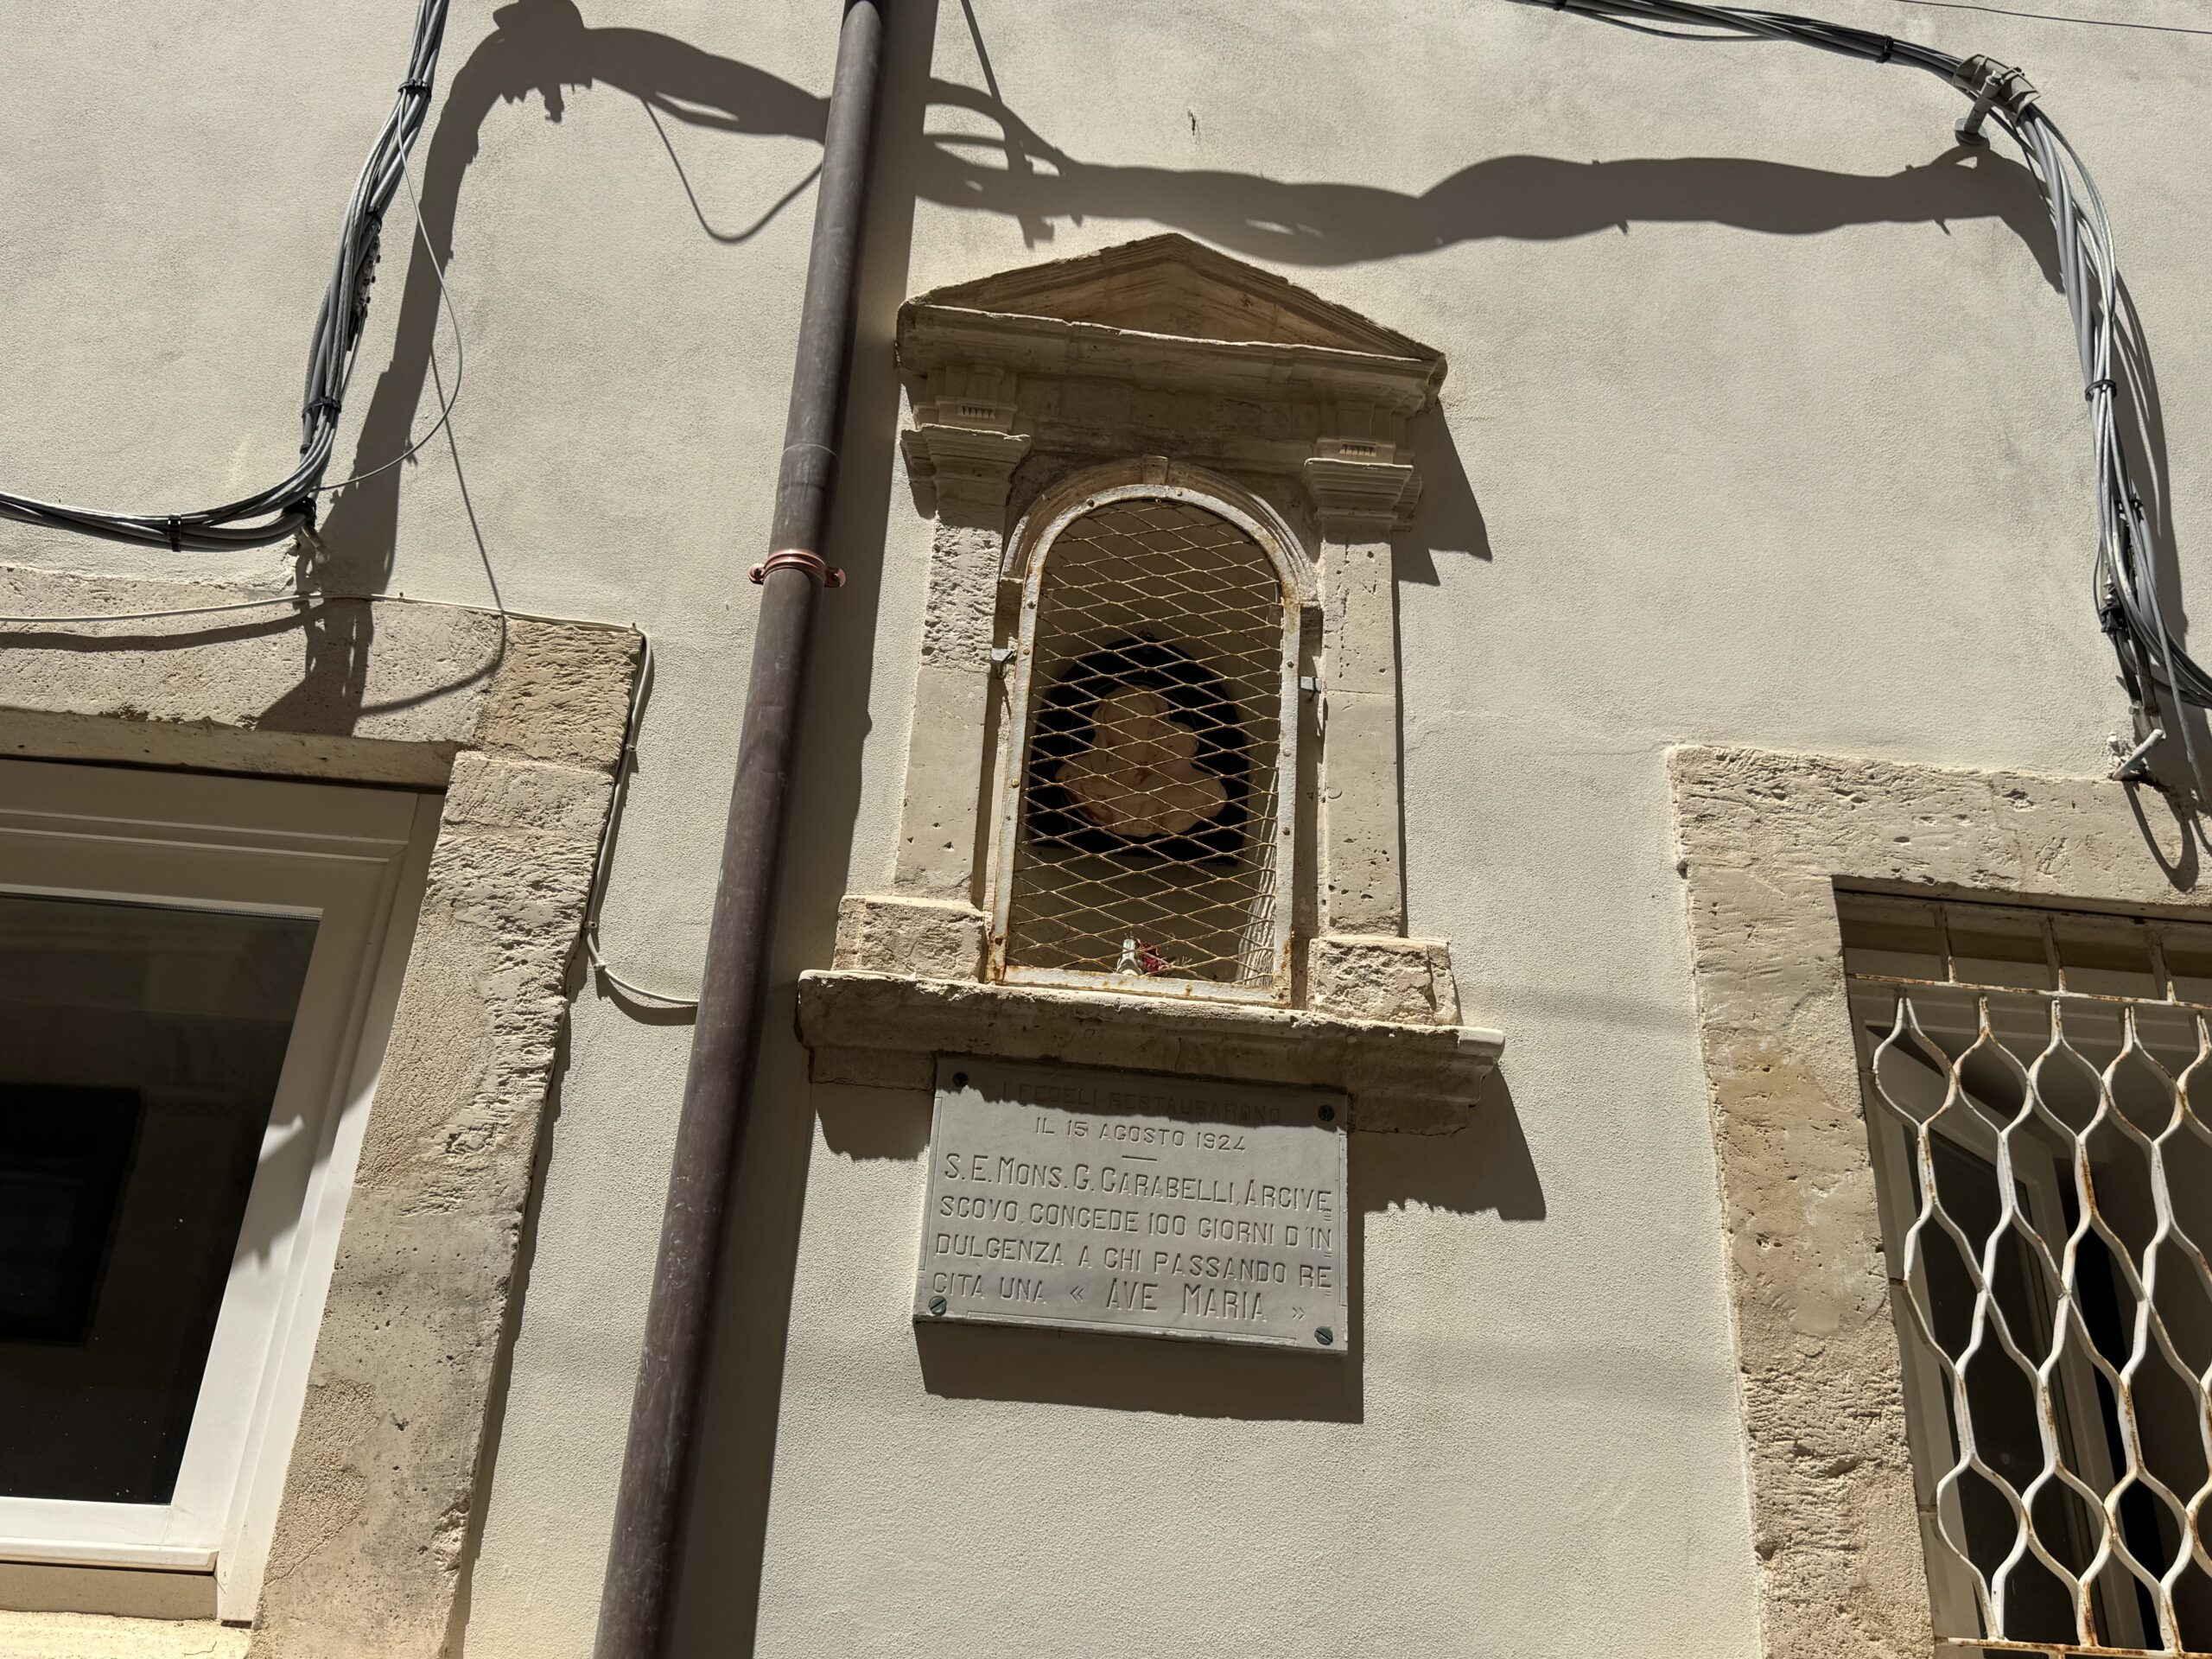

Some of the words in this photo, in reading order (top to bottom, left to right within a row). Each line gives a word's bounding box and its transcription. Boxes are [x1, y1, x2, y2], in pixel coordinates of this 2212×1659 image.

[1018, 1083, 1098, 1107] FEDELI
[1109, 1092, 1281, 1123] RESTAURARONO
[1036, 1116, 1055, 1135] IL
[1067, 1119, 1088, 1137] 15
[1099, 1122, 1185, 1147] AGOSTO
[1197, 1131, 1246, 1154] 1924
[940, 1195, 1024, 1227] SCOVO,
[1030, 1202, 1140, 1233] CONCEDE
[1148, 1211, 1186, 1236] 100
[1198, 1217, 1275, 1246] GIORNI
[936, 1233, 1065, 1267] DULGENZA
[1078, 1245, 1093, 1269] A
[1104, 1247, 1141, 1273] CHI
[1154, 1250, 1287, 1285] PASSANDO
[933, 1271, 985, 1299] CITA
[1000, 1276, 1047, 1305] UNA
[1106, 1277, 1160, 1313] AVE
[1182, 1282, 1268, 1322] MARIA
